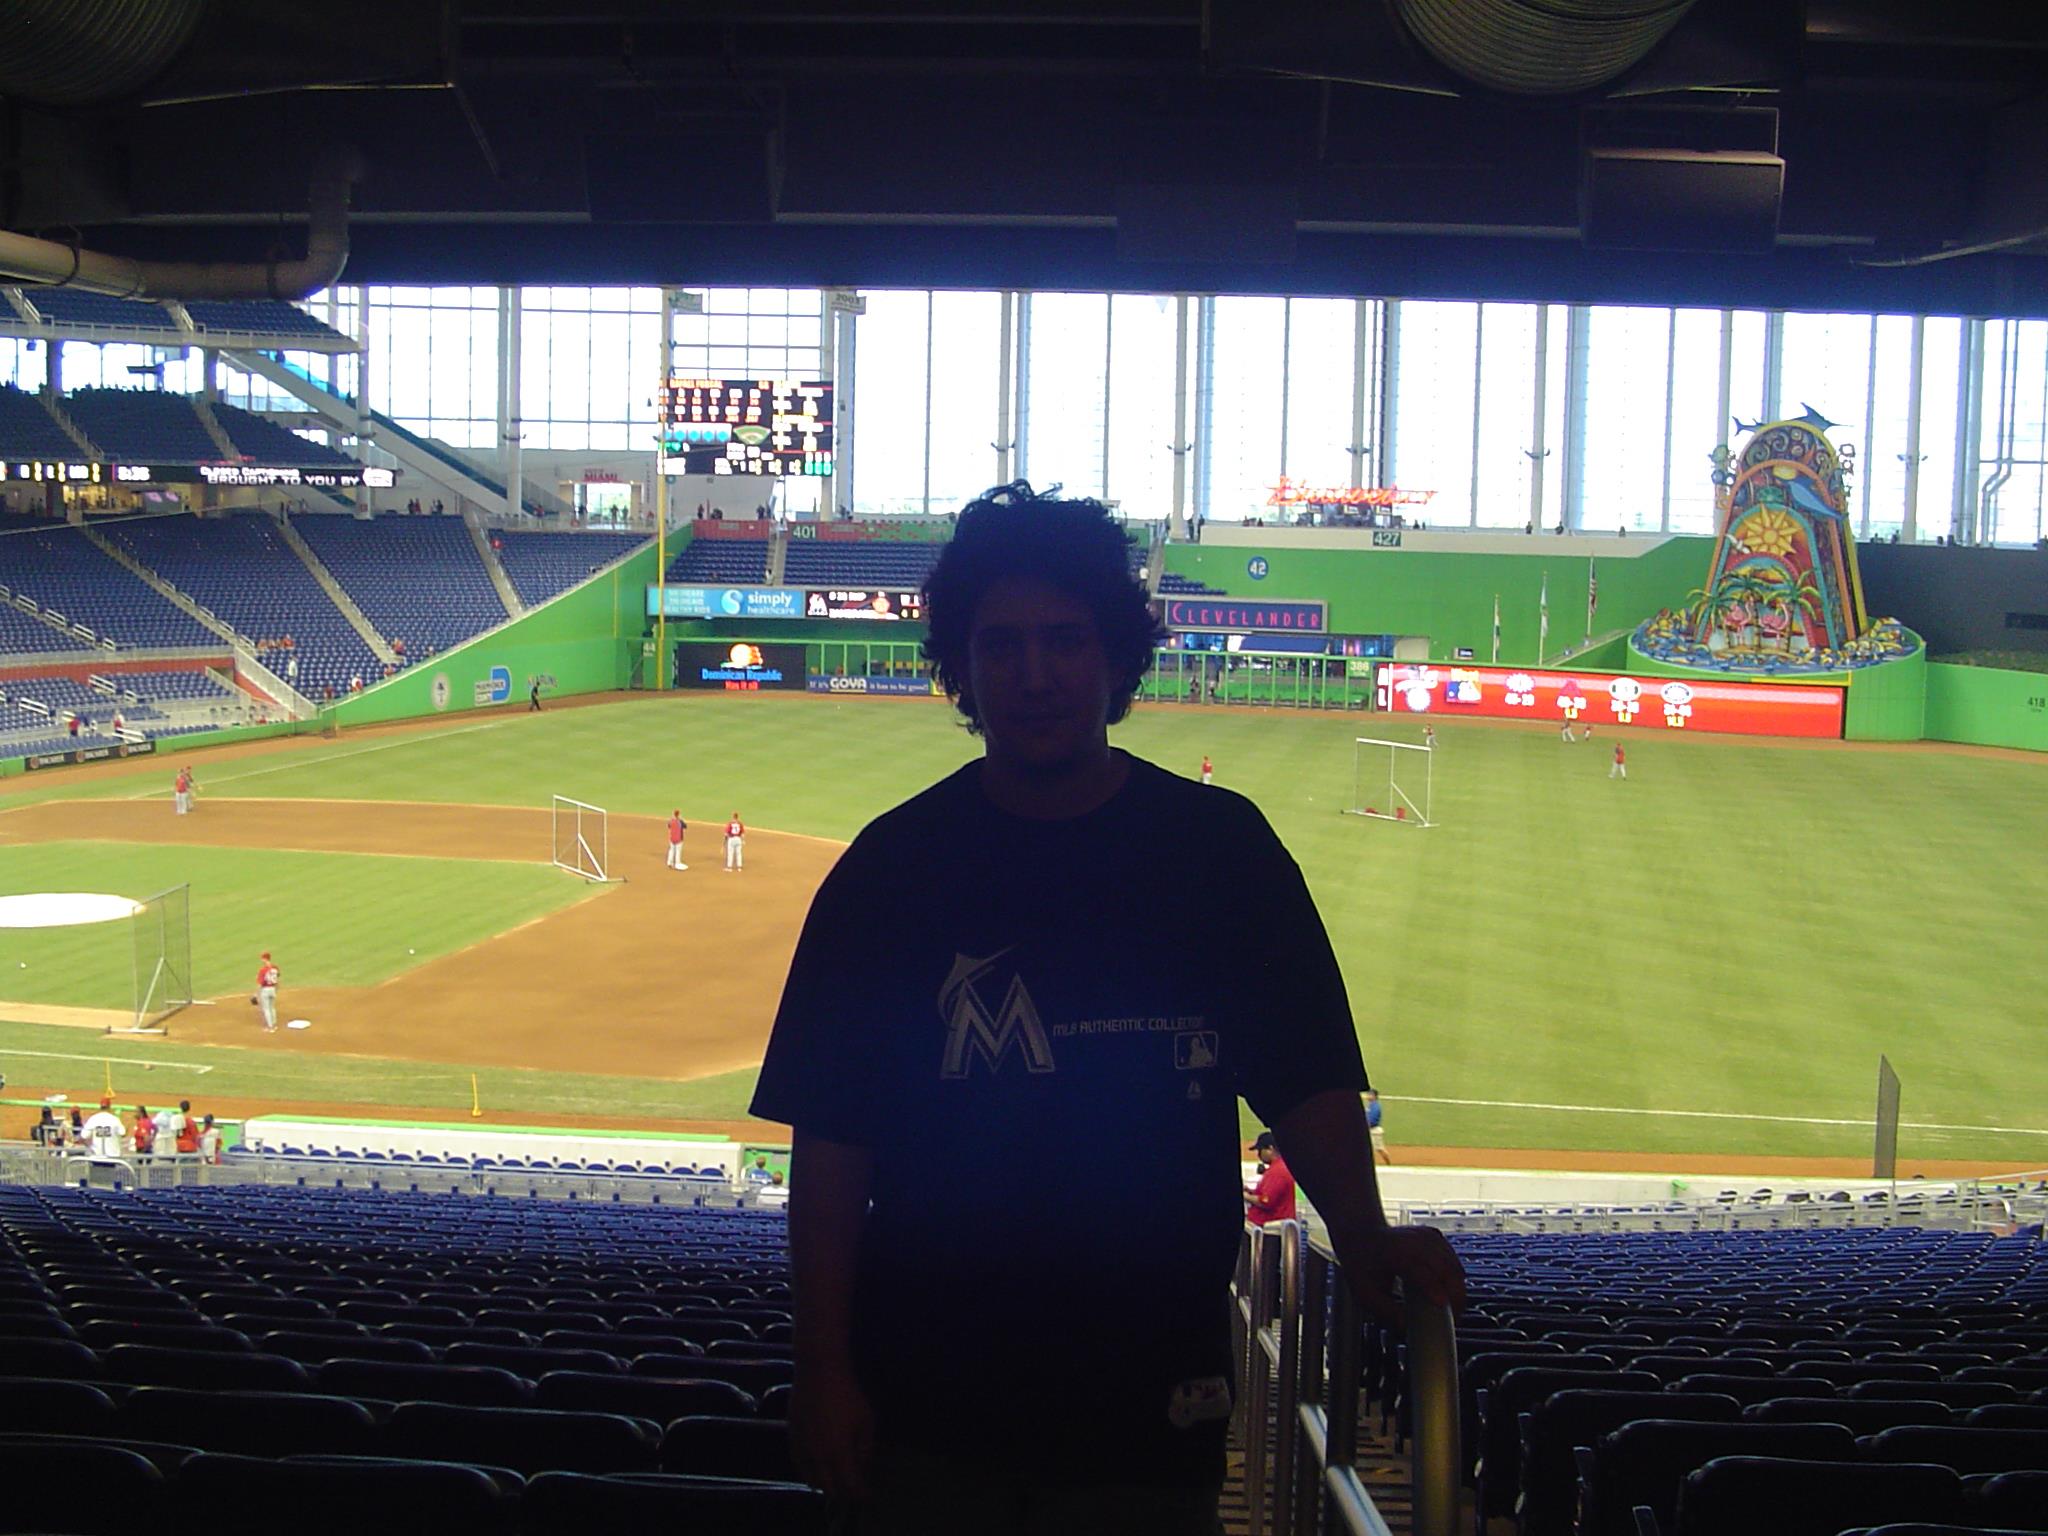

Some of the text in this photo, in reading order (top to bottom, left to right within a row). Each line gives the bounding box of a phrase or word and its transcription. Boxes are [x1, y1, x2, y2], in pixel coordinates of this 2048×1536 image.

[305, 476, 336, 486] YOU
[341, 477, 359, 485] BY
[793, 526, 816, 538] 401
[1373, 532, 1400, 546] 427
[1250, 561, 1266, 575] 42
[747, 591, 792, 607] simply
[702, 668, 782, 681] Dominican Republic
[1079, 1018, 1144, 1034] AUTHENTIC
[96, 1126, 112, 1137] 22
